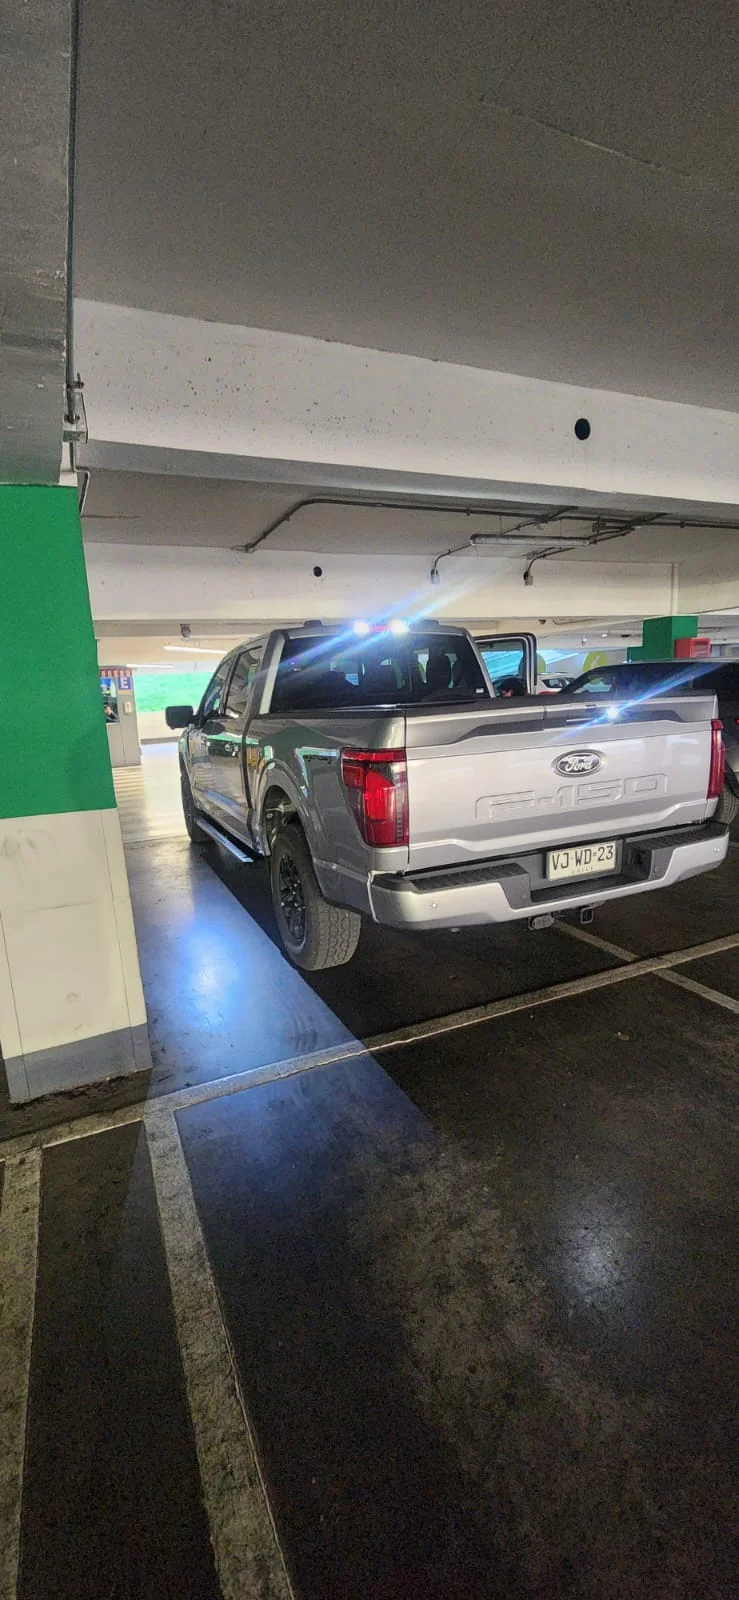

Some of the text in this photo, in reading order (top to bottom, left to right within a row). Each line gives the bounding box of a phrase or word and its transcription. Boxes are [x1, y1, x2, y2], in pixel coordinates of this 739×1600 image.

[120, 678, 128, 689] E
[559, 755, 595, 772] Ford
[475, 773, 667, 818] F-150
